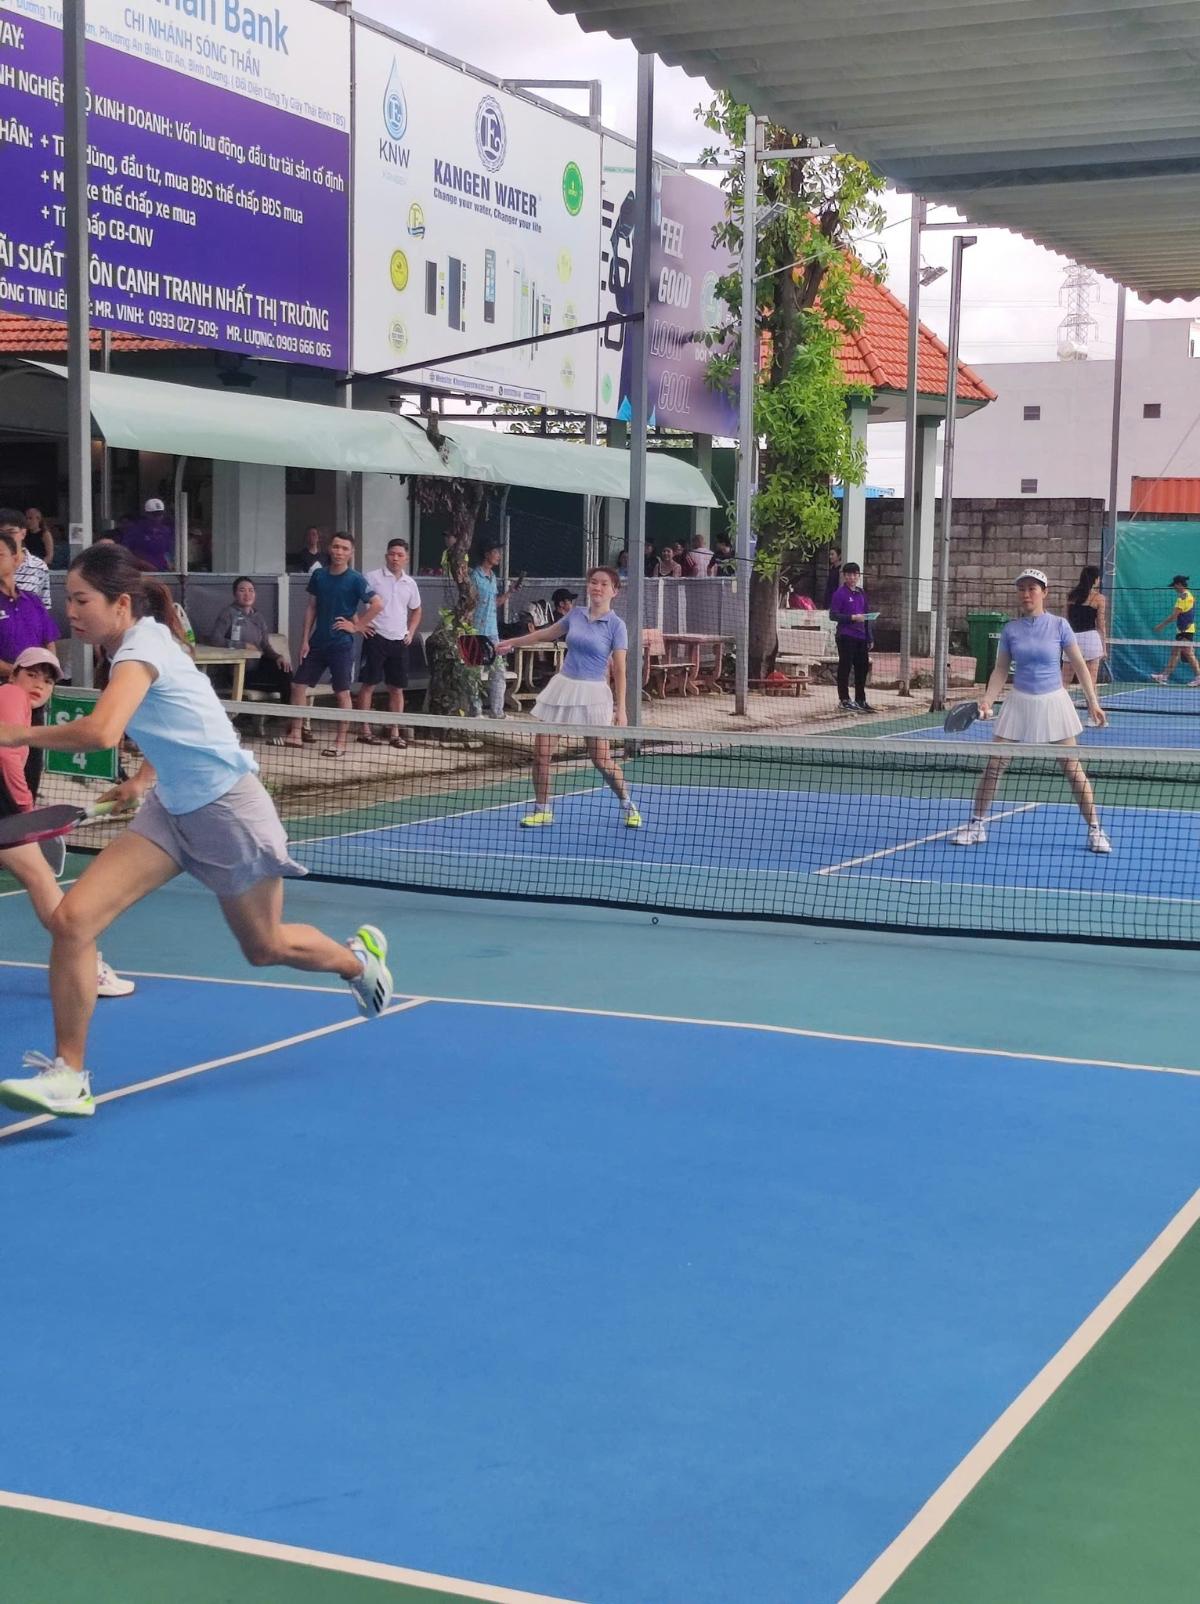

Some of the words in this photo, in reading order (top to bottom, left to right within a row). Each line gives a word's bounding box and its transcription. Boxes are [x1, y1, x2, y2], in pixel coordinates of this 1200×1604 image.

[124, 8, 145, 32] CHI
[224, 0, 289, 55] Bank
[95, 94, 125, 123] KINH
[127, 105, 174, 137] DOANH:
[175, 121, 197, 146] Vốn
[199, 129, 216, 151] lưu
[218, 135, 246, 164] động,
[248, 144, 267, 168] đầu
[269, 153, 280, 171] tư
[281, 156, 294, 175] tài
[295, 159, 311, 181] sản
[312, 165, 324, 185] cố
[324, 171, 344, 192] định
[379, 137, 411, 169] KNW
[101, 183, 123, 207] thế
[125, 190, 153, 219] chấp
[155, 201, 170, 220] xe
[172, 206, 197, 226] mua
[121, 154, 144, 179] đầu
[146, 165, 162, 186] tư,
[165, 172, 189, 193] mua
[191, 176, 213, 199] BĐS
[215, 184, 234, 205] thế
[235, 189, 259, 215] chấp
[261, 196, 281, 218] BĐS
[283, 205, 304, 225] mua
[433, 158, 490, 201] KANGEN
[495, 180, 537, 218] WATER
[433, 187, 457, 205] Change
[458, 197, 473, 210] your
[474, 201, 493, 218] water,
[518, 218, 531, 230] your
[109, 219, 154, 248] CB-CNV
[660, 215, 684, 259] FEEL
[18, 240, 65, 277] SUẤT
[117, 265, 160, 298] CẠNH
[162, 274, 212, 309] TRANH
[215, 283, 254, 316] NHẤT
[255, 295, 277, 327] THỊ
[279, 300, 330, 331] TRƯỜNG
[657, 266, 692, 309] GOOD
[27, 286, 47, 307] TIN
[95, 299, 115, 319] MR.
[116, 303, 145, 325] VINH:
[148, 309, 175, 330] 0933
[176, 315, 196, 335] 027
[197, 320, 219, 340] 509;
[226, 325, 243, 342] MR.
[243, 327, 275, 349] LƯỢNG:
[276, 333, 299, 352] 0903
[299, 338, 315, 355] 666
[315, 343, 332, 359] 065
[657, 370, 691, 414] COOL
[72, 752, 87, 770] 4
